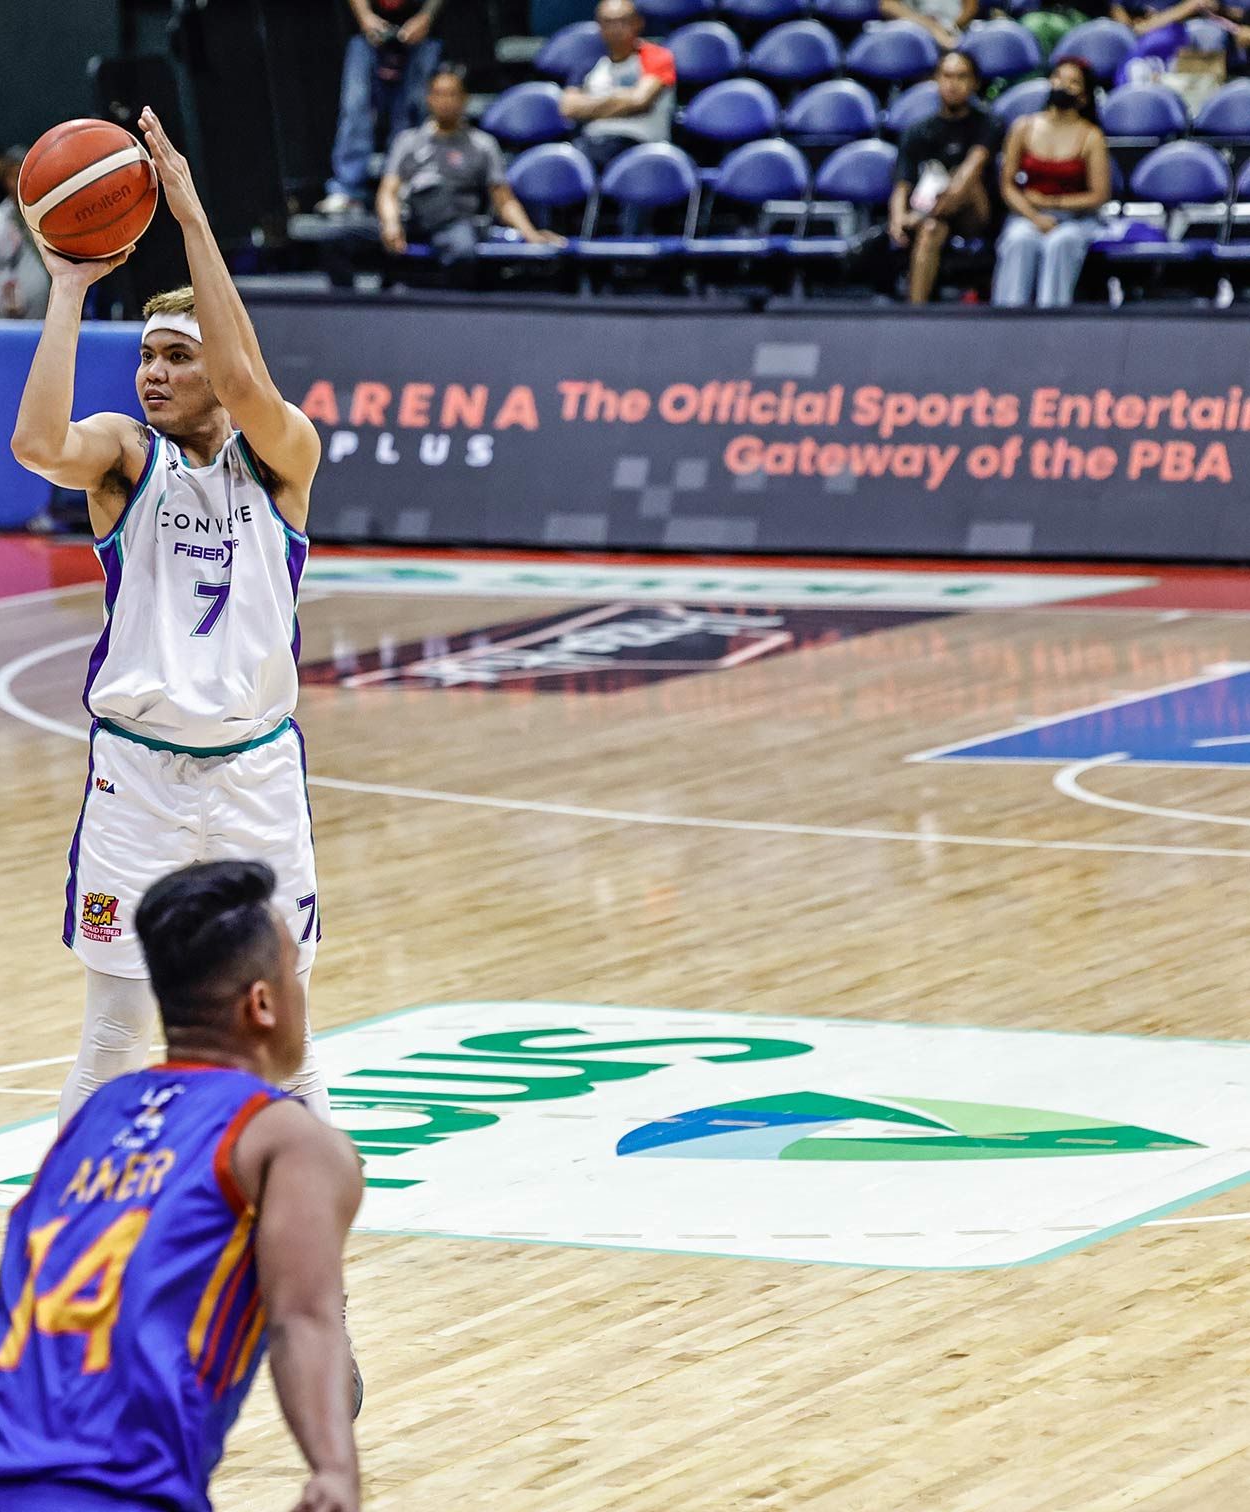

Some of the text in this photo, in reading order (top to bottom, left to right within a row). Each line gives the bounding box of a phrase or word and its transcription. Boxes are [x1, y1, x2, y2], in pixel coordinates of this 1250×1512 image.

[75, 184, 132, 222] molten
[301, 380, 540, 430] ARENA
[560, 381, 651, 423] The
[658, 381, 845, 425] Official
[852, 386, 1020, 439] Sports
[328, 431, 494, 467] PLUS
[724, 434, 1232, 490] Gateway of the PBA
[190, 580, 231, 637] 7
[83, 907, 112, 925] SAWA
[86, 892, 116, 908] SURF
[296, 891, 317, 944] 7
[100, 928, 120, 937] FIBER
[58, 1147, 177, 1206] AMER
